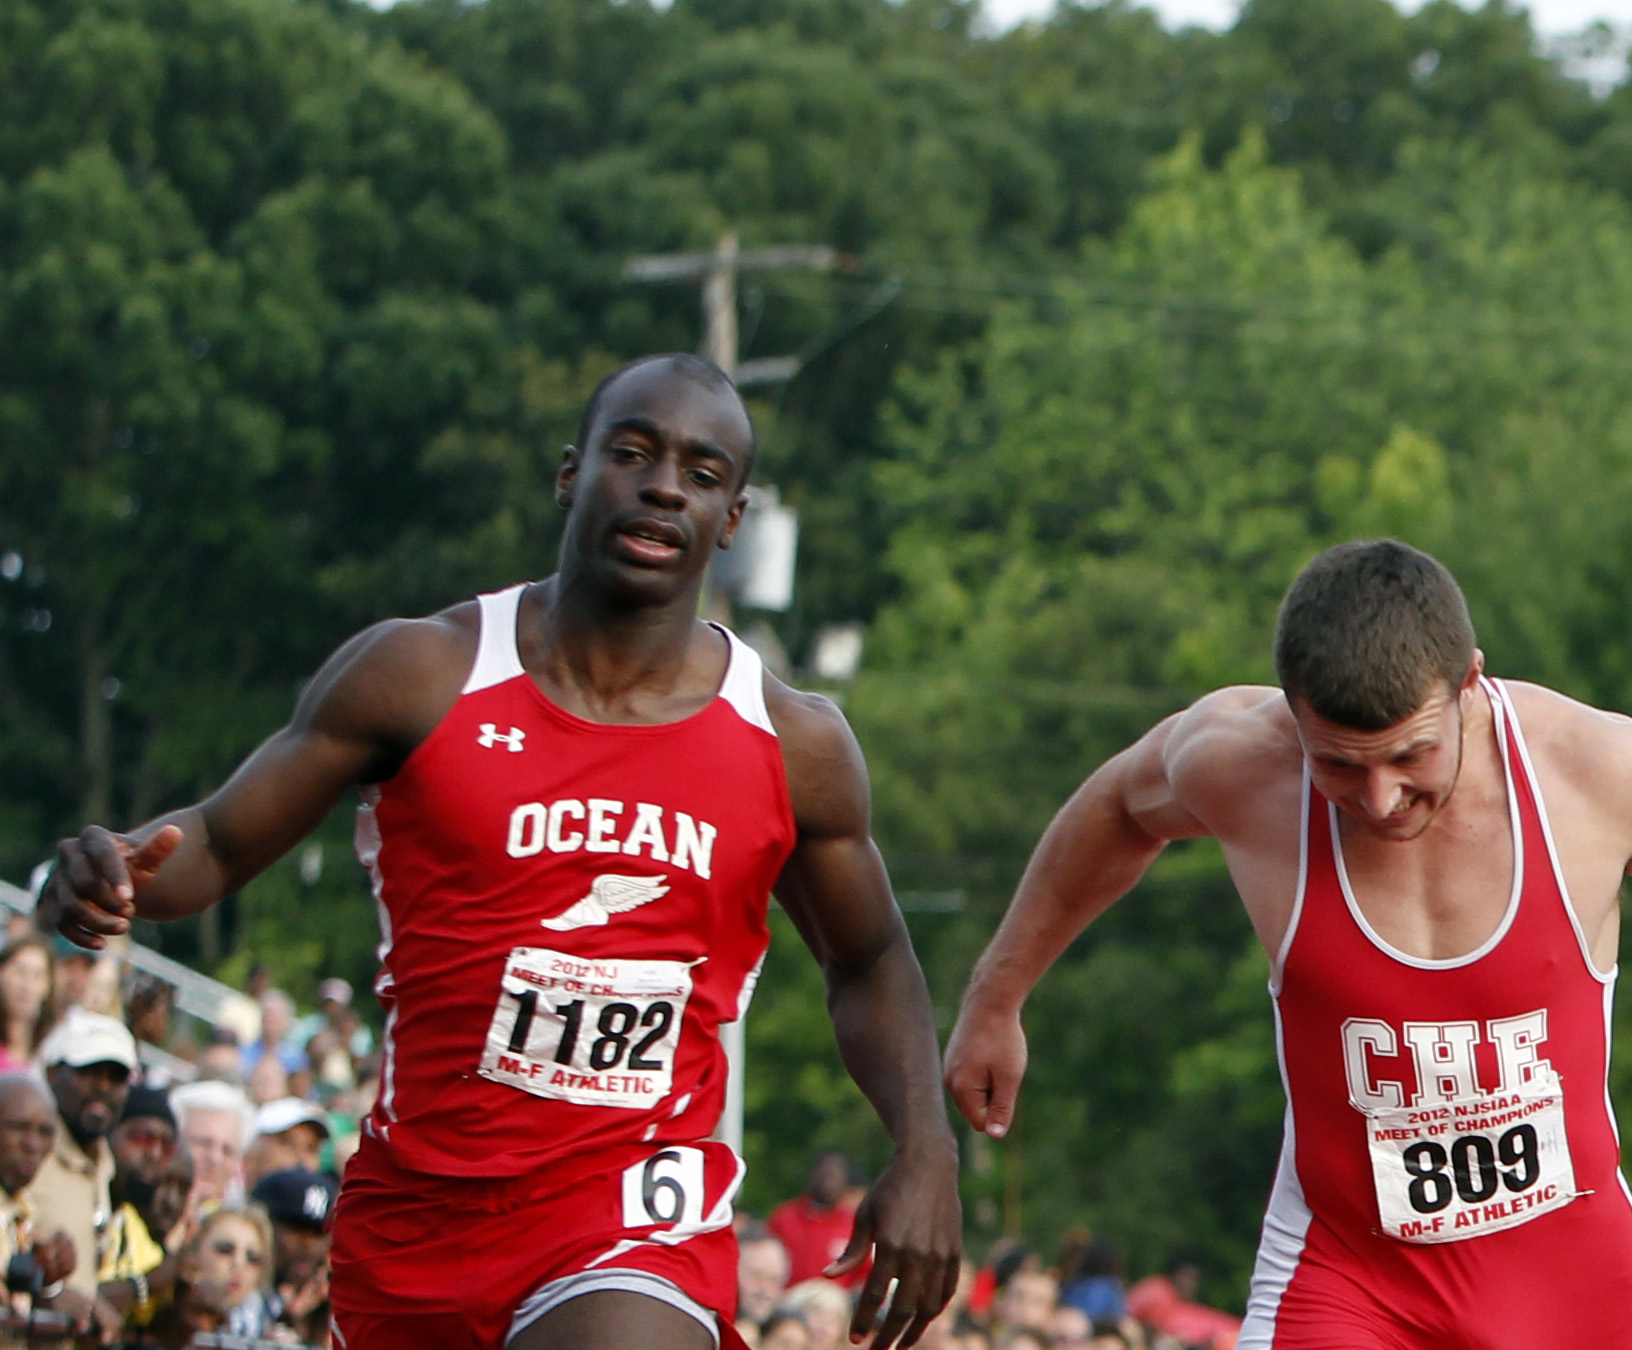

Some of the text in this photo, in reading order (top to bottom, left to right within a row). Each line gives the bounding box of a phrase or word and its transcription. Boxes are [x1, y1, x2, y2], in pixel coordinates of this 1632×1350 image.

[506, 798, 718, 880] OCEAN
[511, 966, 558, 988] MEET
[564, 980, 584, 992] OF
[551, 959, 590, 978] 2012
[508, 989, 674, 1072] 1182
[497, 1055, 655, 1094] M-F ATHLETIC
[1375, 1097, 1554, 1143] MEET OF CHAMPIONS
[1407, 1094, 1522, 1125] 2012 NJSIAA
[641, 1151, 687, 1223] 6
[1402, 1123, 1541, 1214] 809
[1400, 1216, 1446, 1238] M-F
[1455, 1184, 1557, 1229] ATHLETIC
